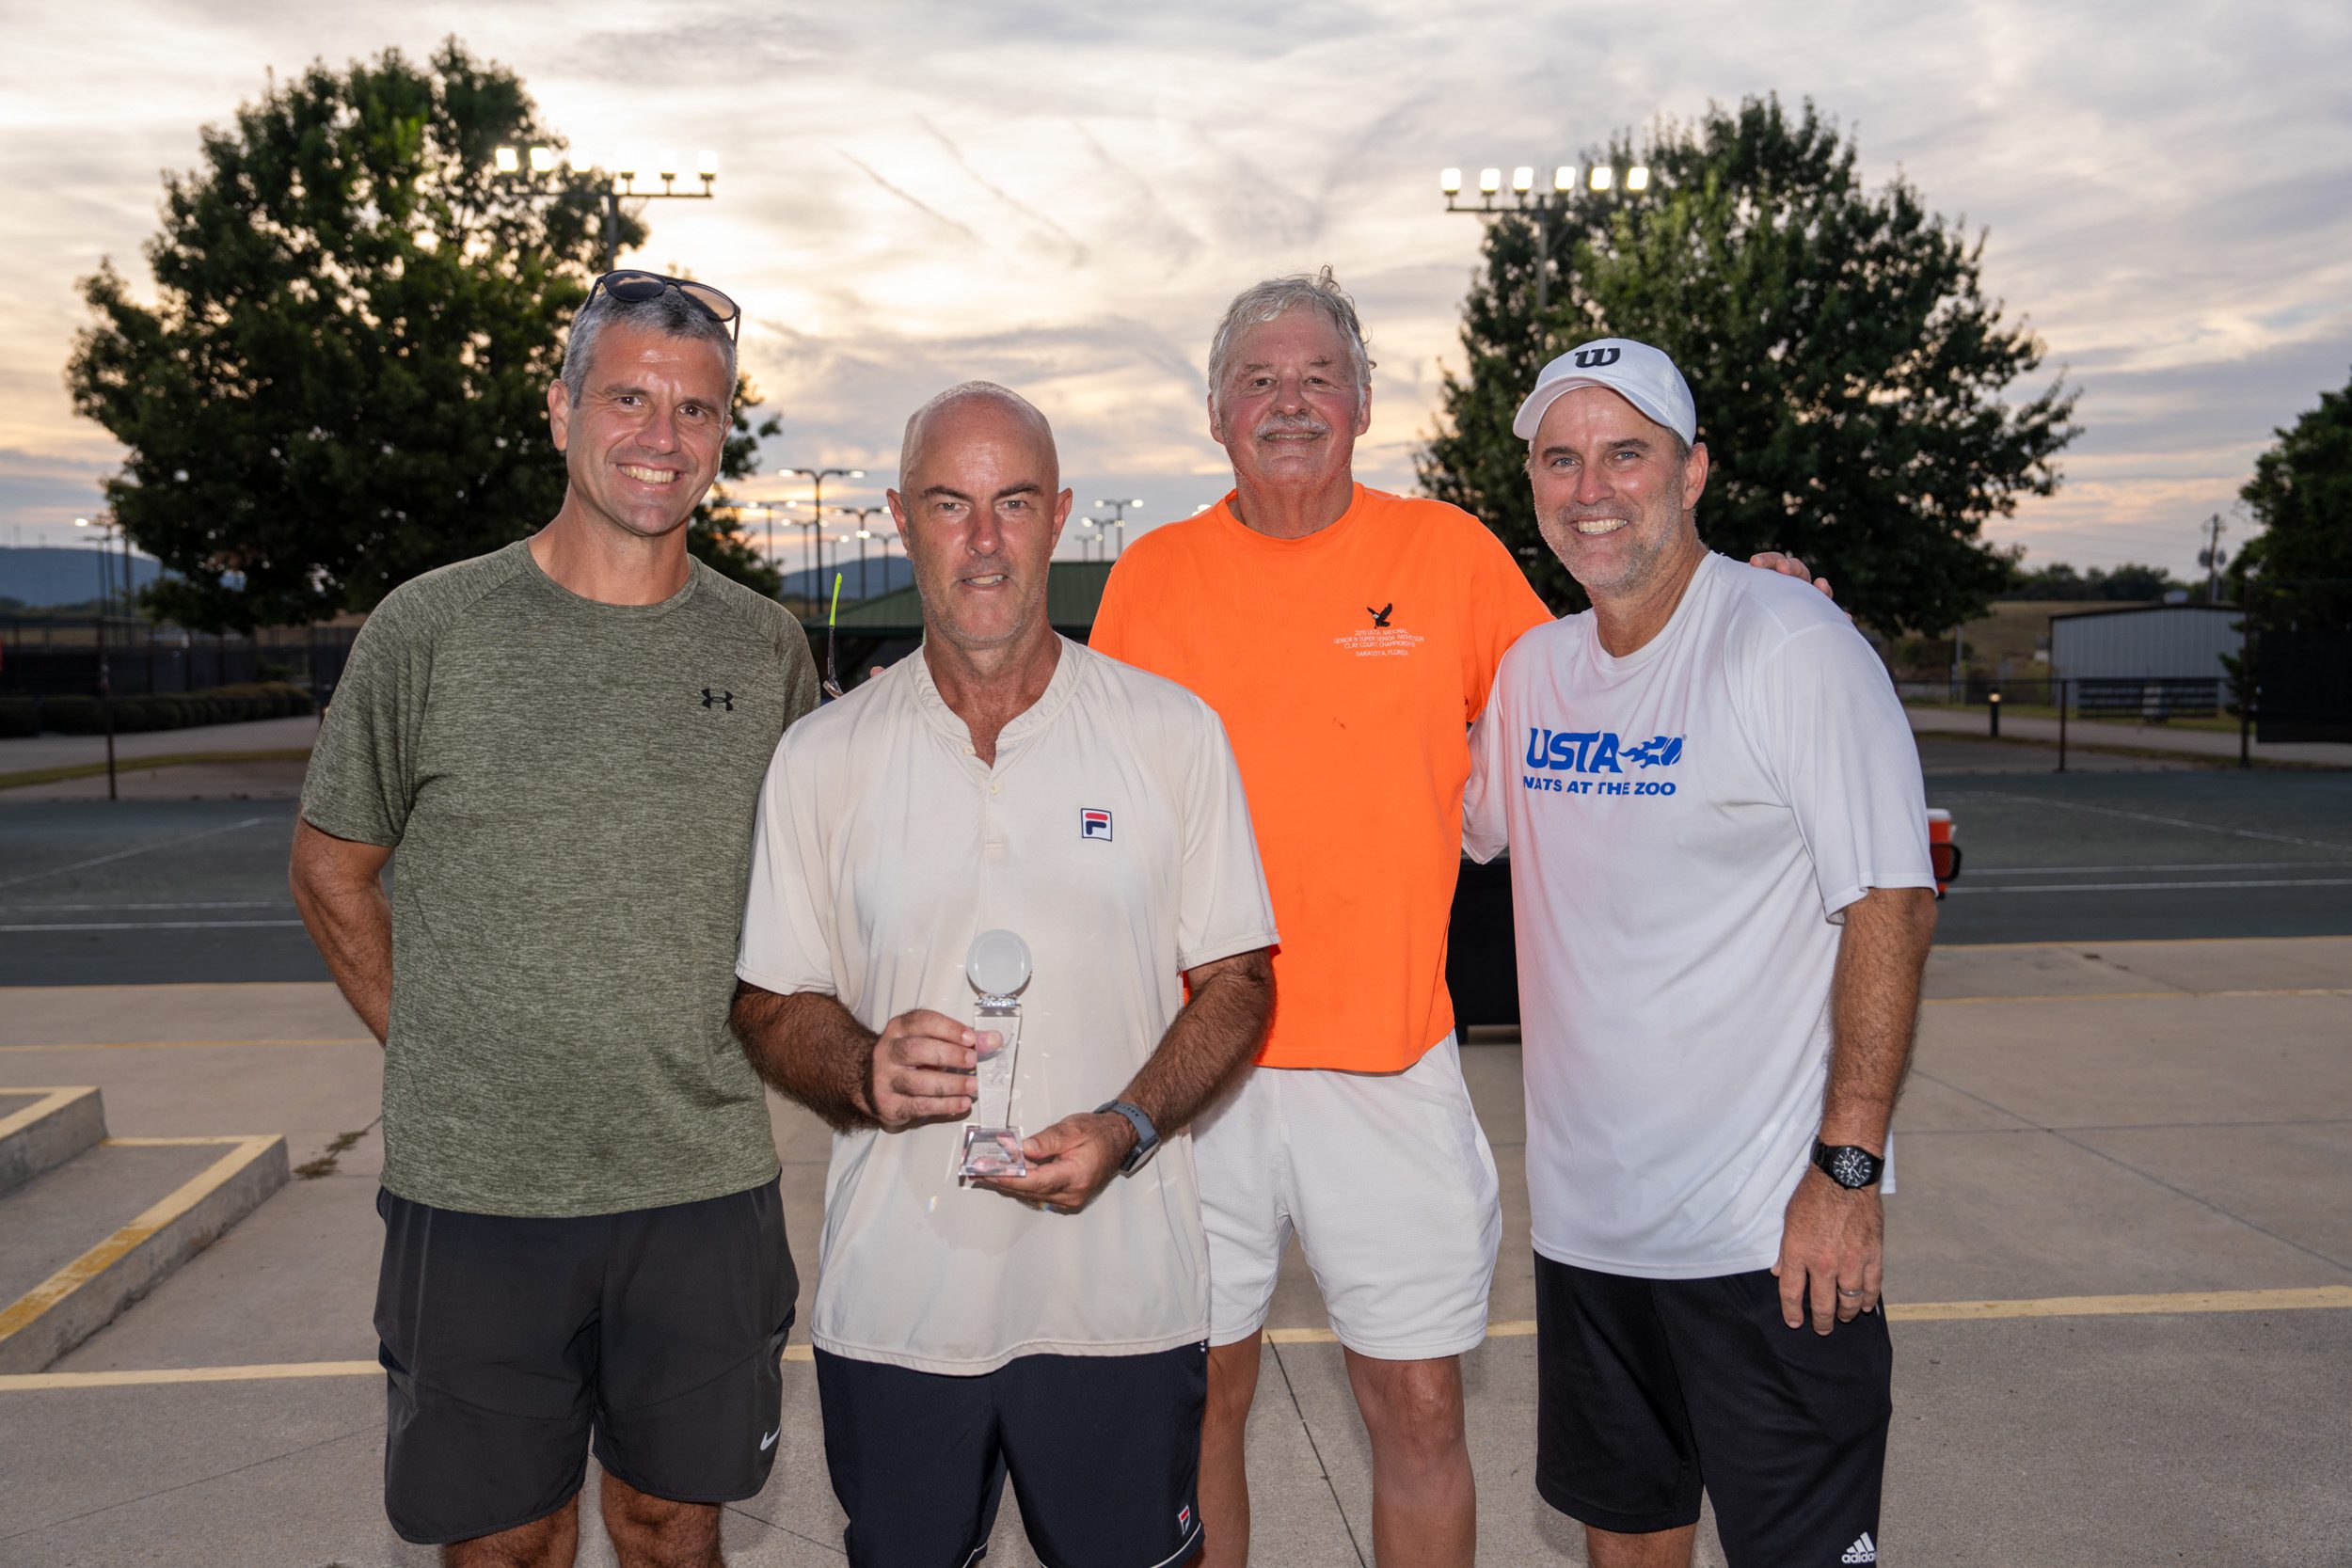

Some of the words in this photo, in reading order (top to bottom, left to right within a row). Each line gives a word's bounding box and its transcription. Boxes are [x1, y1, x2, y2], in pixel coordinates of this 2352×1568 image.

[1526, 727, 1623, 773] USTA
[1523, 776, 1563, 792] NATS
[1566, 782, 1593, 795] AT
[1597, 782, 1630, 796] THE
[1634, 782, 1677, 796] ZOO
